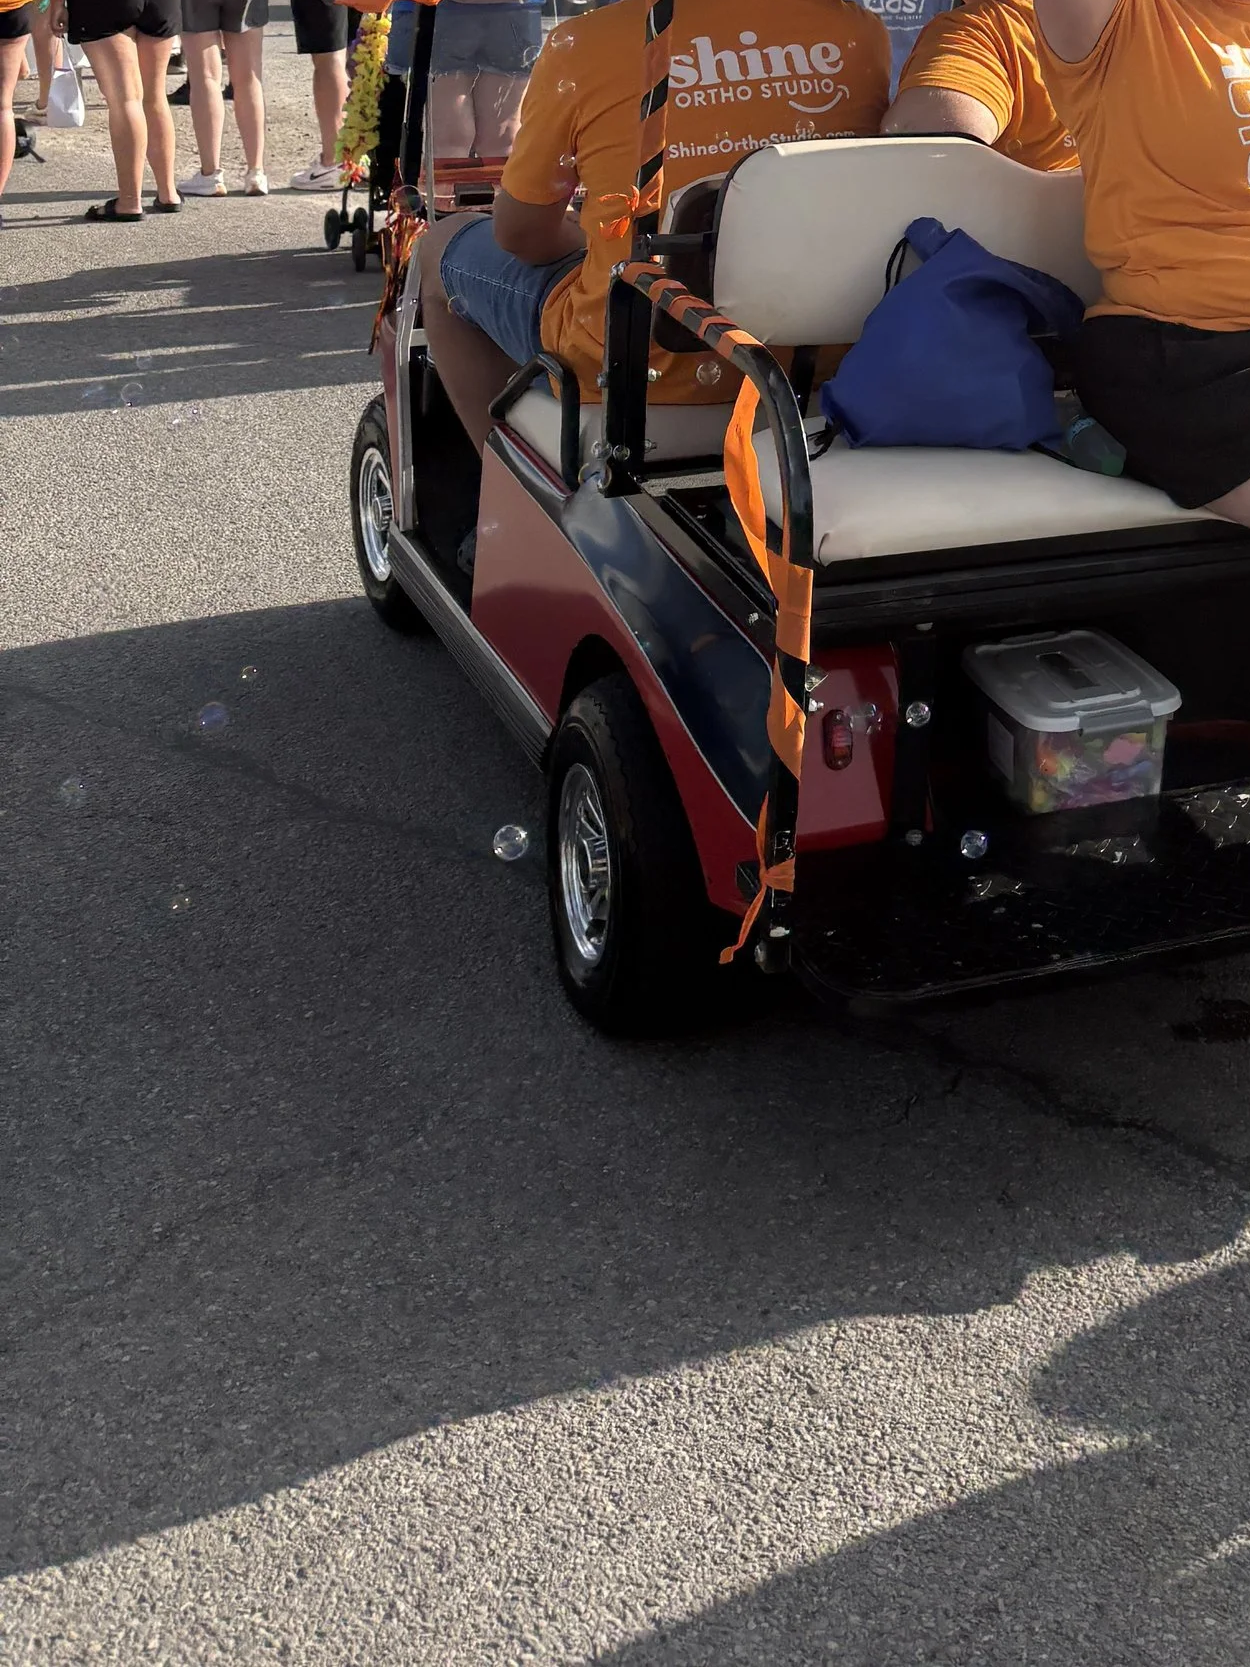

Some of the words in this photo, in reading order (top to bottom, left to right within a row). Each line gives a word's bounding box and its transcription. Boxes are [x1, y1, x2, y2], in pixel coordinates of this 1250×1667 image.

[669, 31, 844, 89] shine
[675, 85, 752, 109] ORTHO
[760, 78, 834, 99] STUDIO
